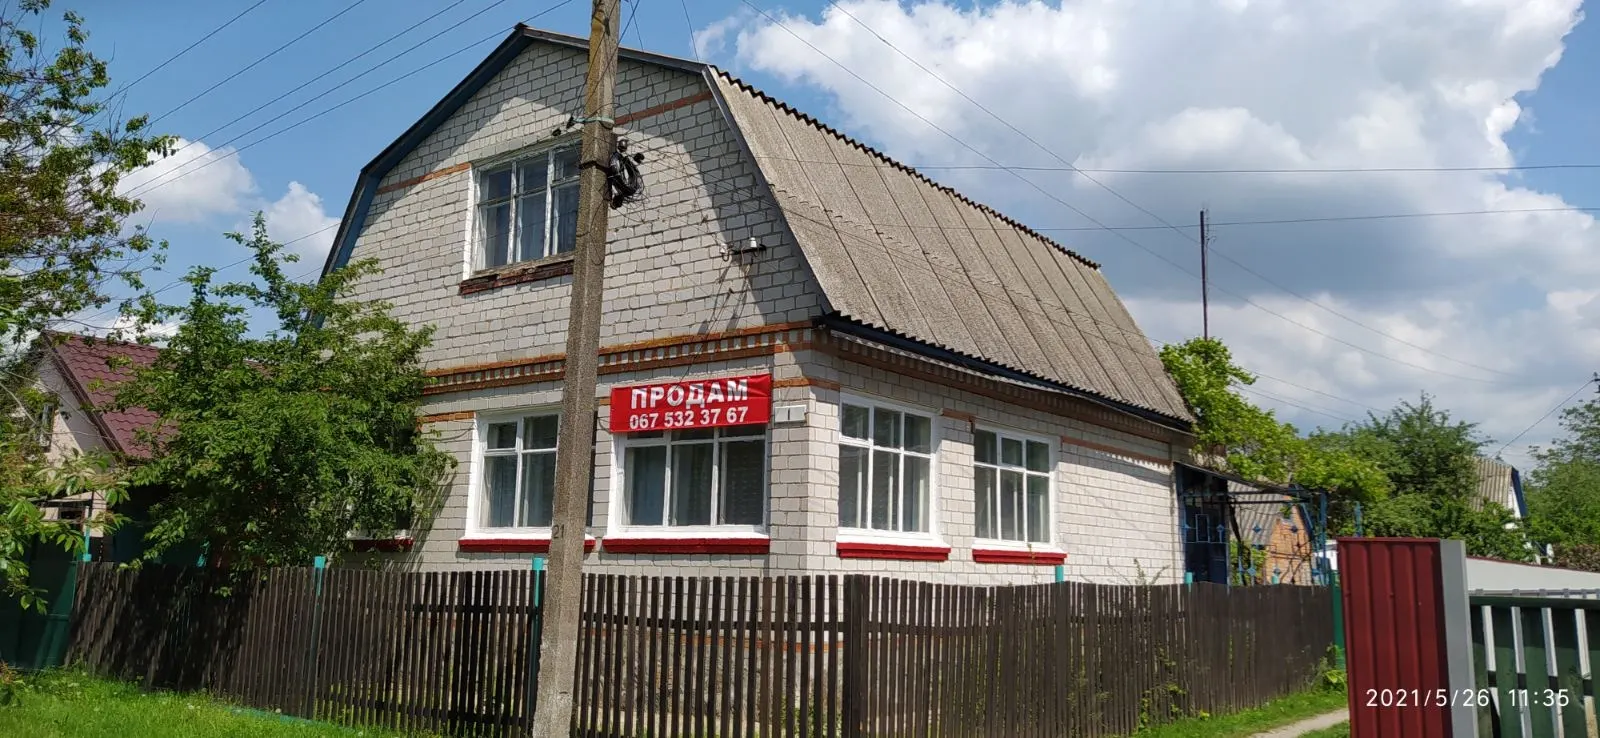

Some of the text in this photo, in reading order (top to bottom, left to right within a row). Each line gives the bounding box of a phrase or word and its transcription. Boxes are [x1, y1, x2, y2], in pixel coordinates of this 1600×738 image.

[631, 379, 748, 409] ПРОДАМ
[629, 406, 749, 429] 067 532 37 67
[552, 524, 565, 539] 21
